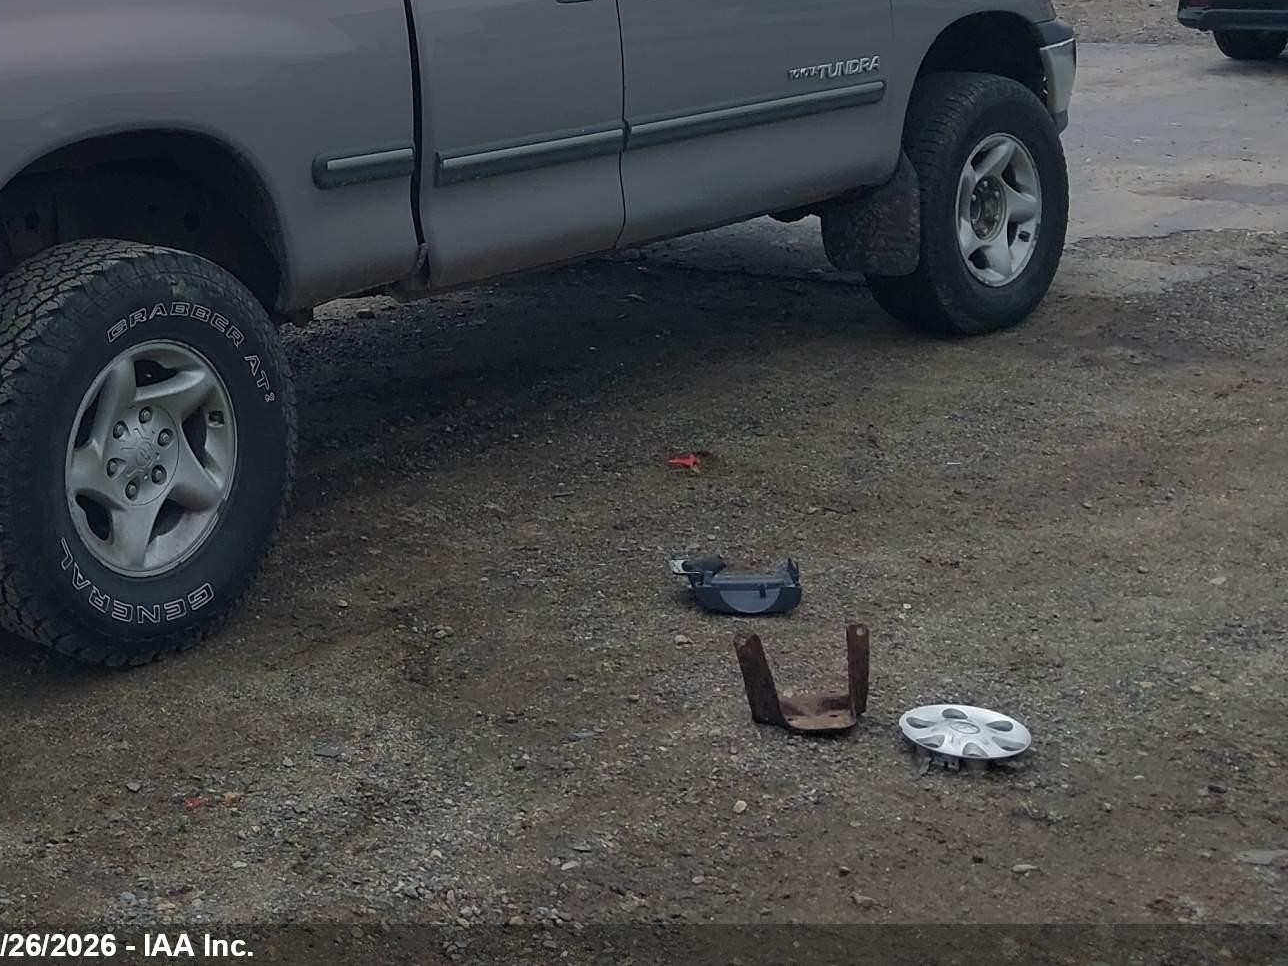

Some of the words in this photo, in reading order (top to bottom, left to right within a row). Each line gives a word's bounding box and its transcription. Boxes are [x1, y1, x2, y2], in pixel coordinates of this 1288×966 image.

[817, 55, 880, 79] TUNDRA
[106, 301, 245, 348] GRABBER
[60, 537, 215, 624] GENERAL
